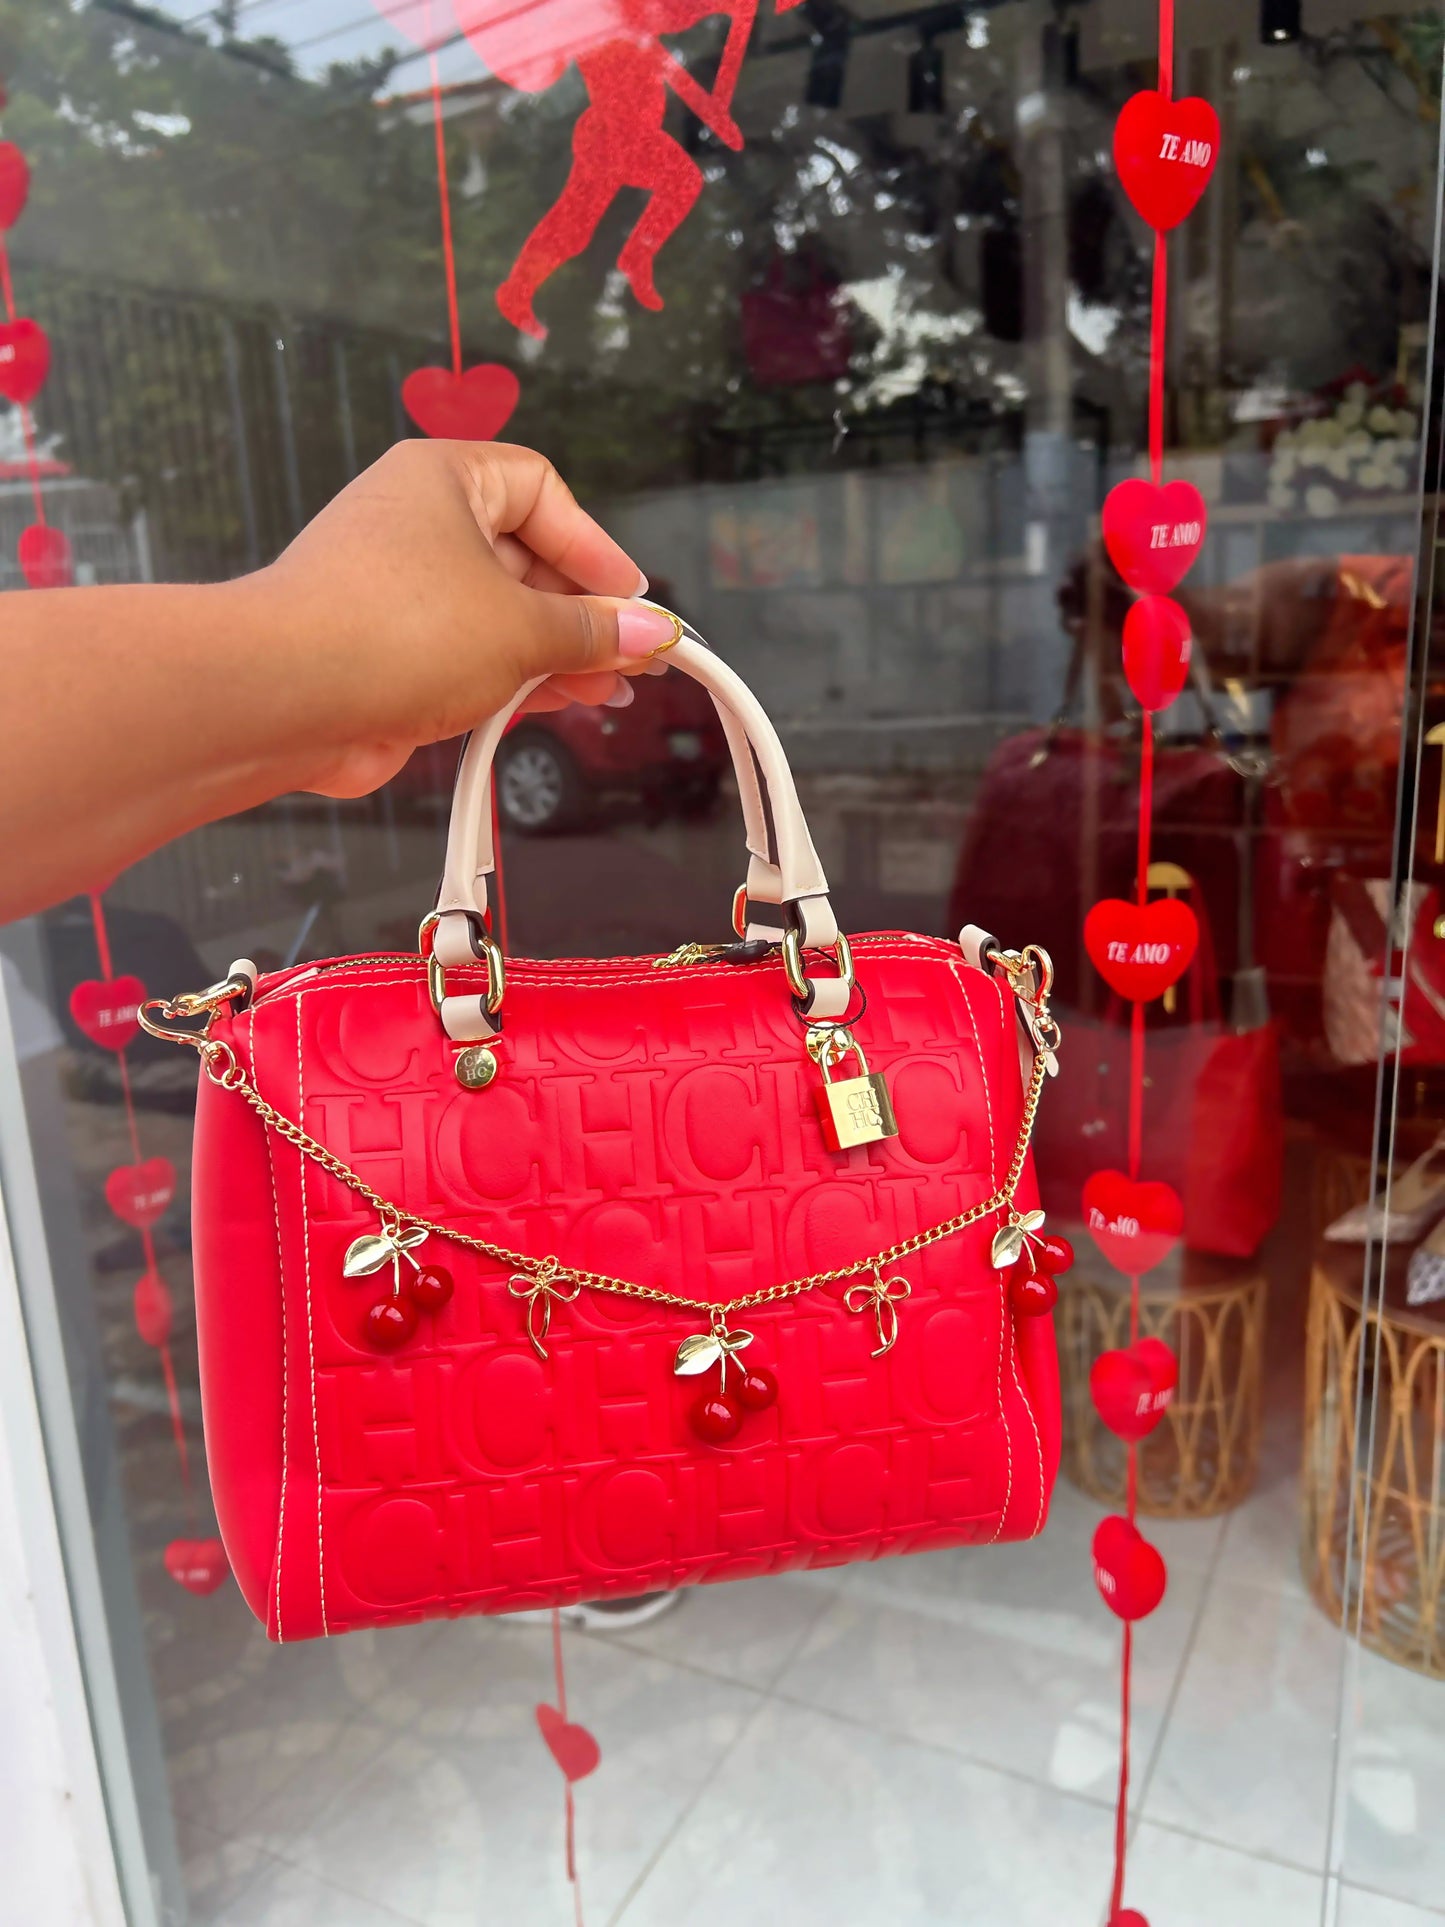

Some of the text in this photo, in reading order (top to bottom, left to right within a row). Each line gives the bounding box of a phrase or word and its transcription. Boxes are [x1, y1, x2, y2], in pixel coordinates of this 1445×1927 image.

[1159, 133, 1212, 168] TE AMO
[1150, 521, 1201, 549] TE AMO
[1107, 941, 1171, 965] TE AMO
[466, 1066, 488, 1081] HC
[847, 1087, 879, 1111] CH
[849, 1108, 883, 1130] HC
[1088, 1207, 1106, 1230] TE
